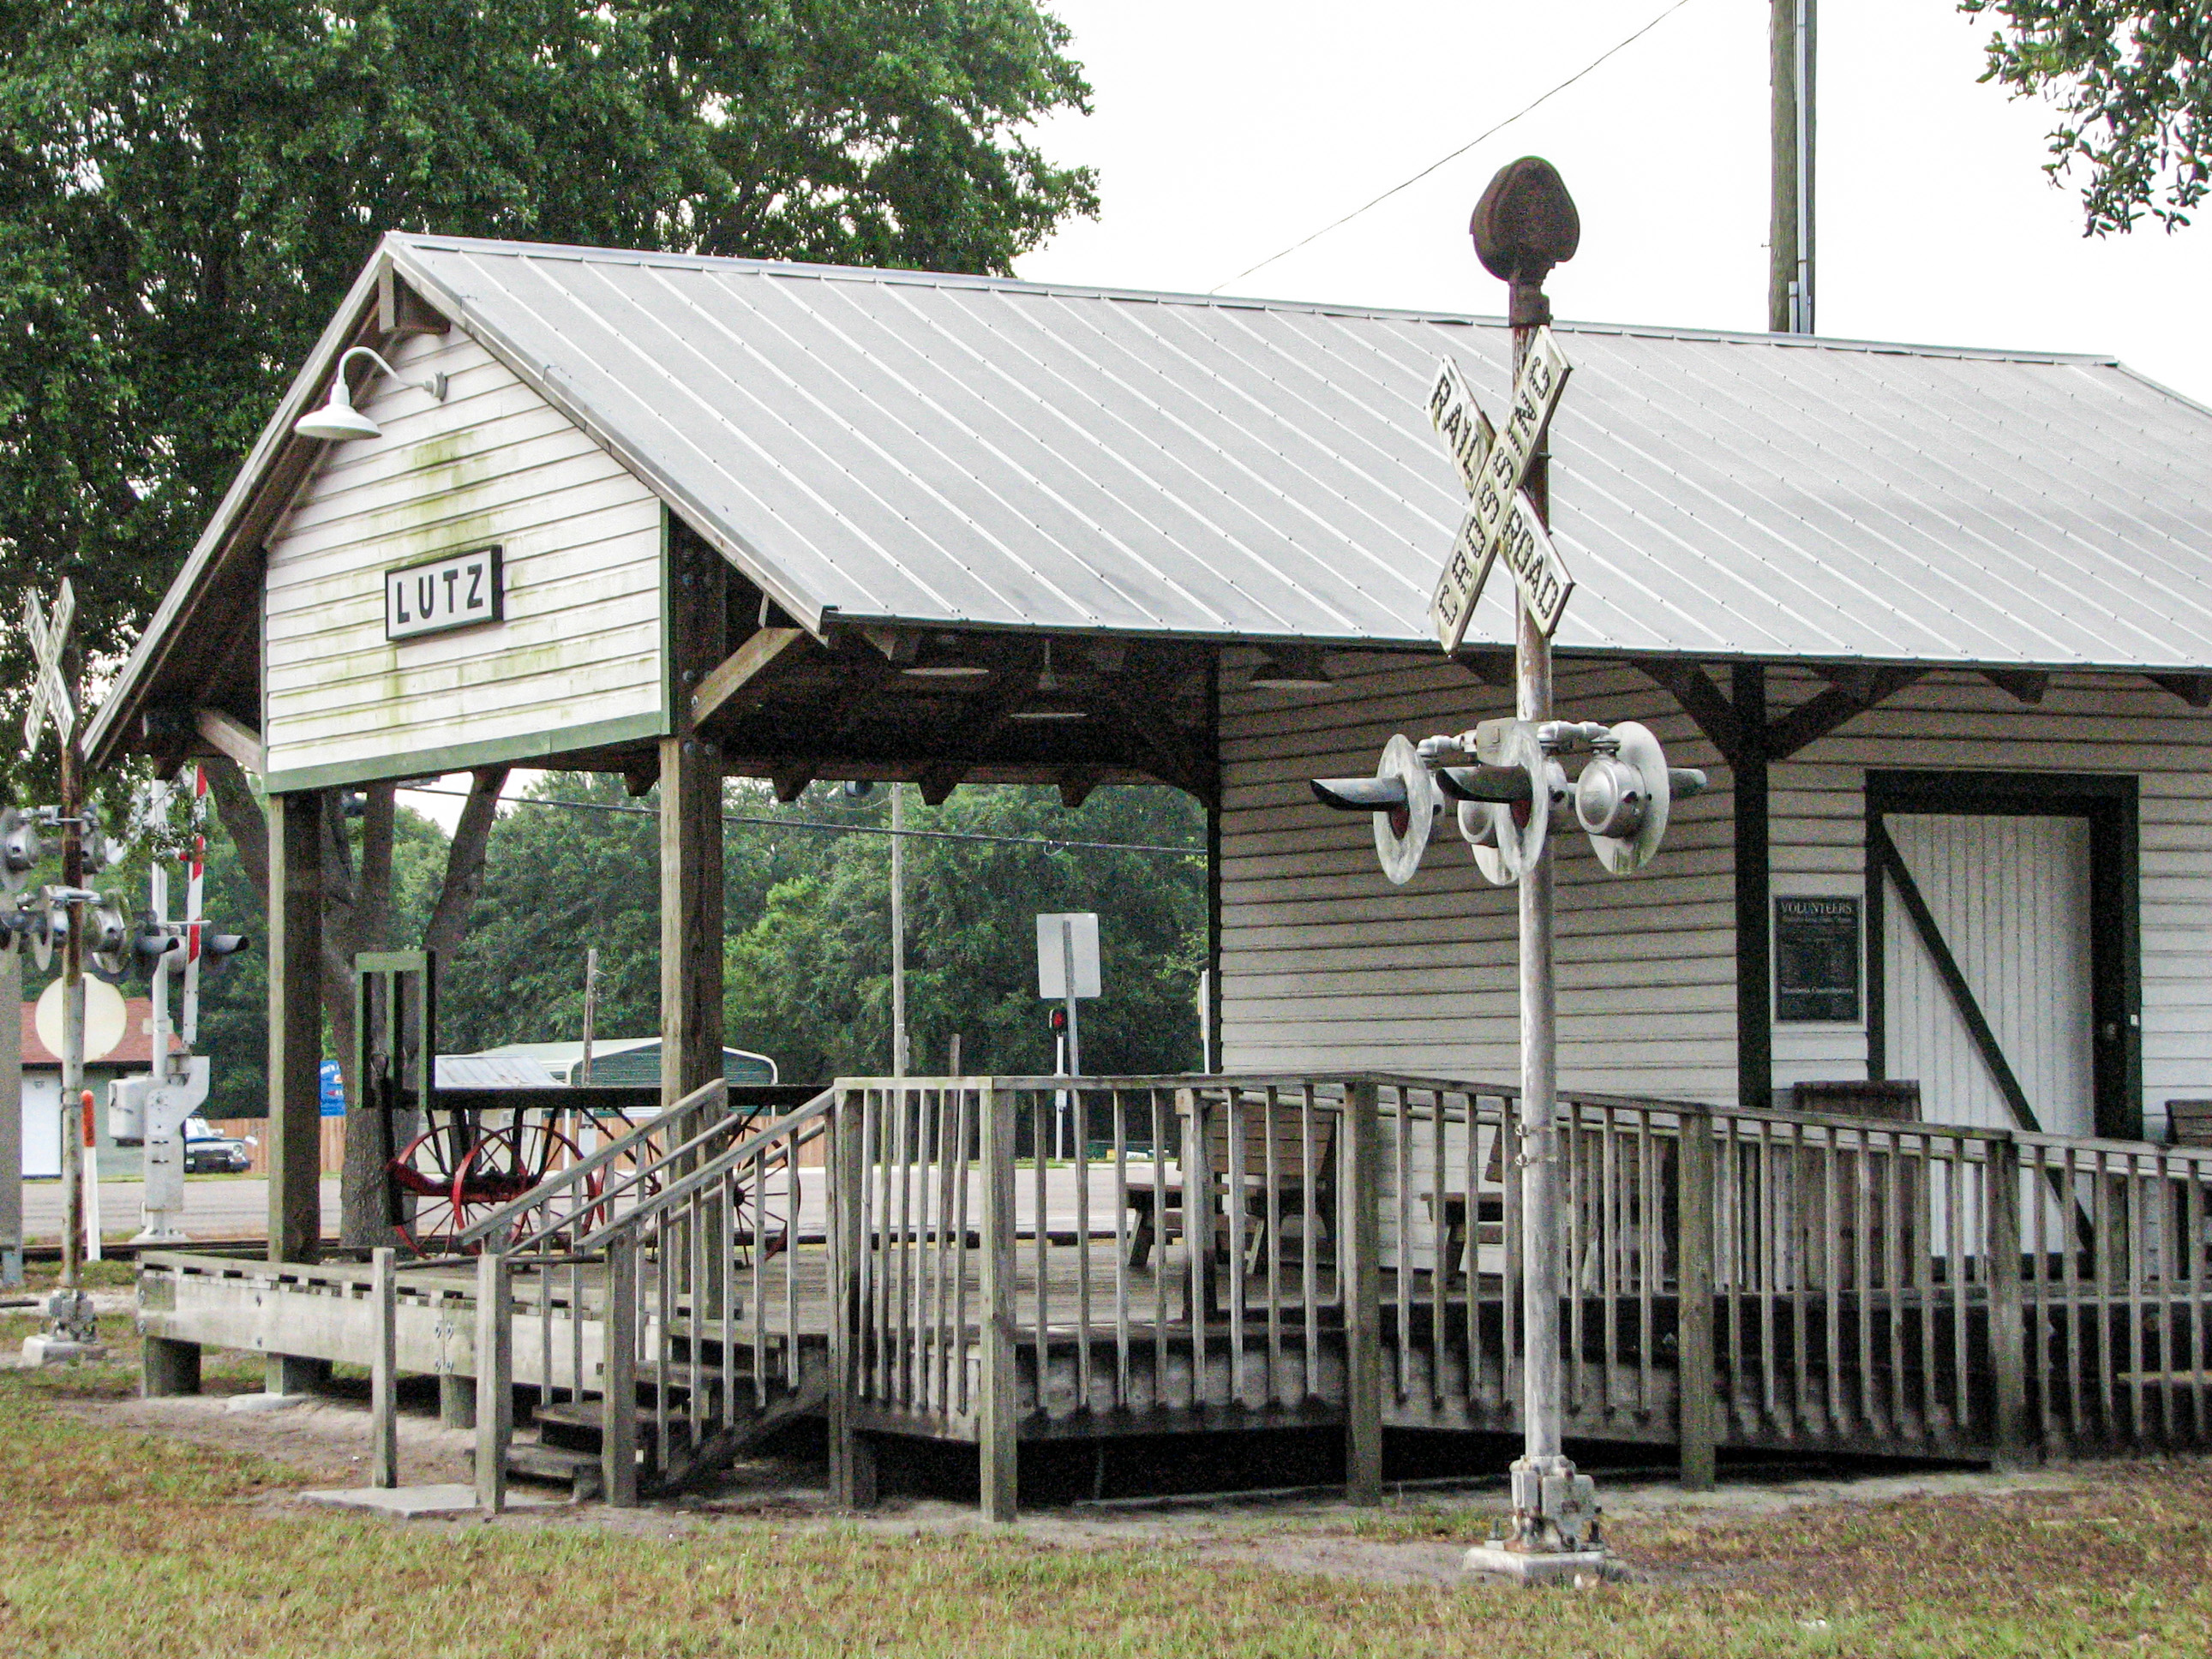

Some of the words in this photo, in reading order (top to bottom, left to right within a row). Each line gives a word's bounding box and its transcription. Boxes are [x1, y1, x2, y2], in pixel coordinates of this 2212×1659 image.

[1430, 374, 1479, 482] RAIL
[1439, 356, 1551, 626] CROSSING
[397, 563, 483, 625] LUTZ
[1502, 505, 1558, 620] ROAD
[50, 674, 70, 739] ROAD
[1781, 901, 1852, 915] VOLUNTEERS
